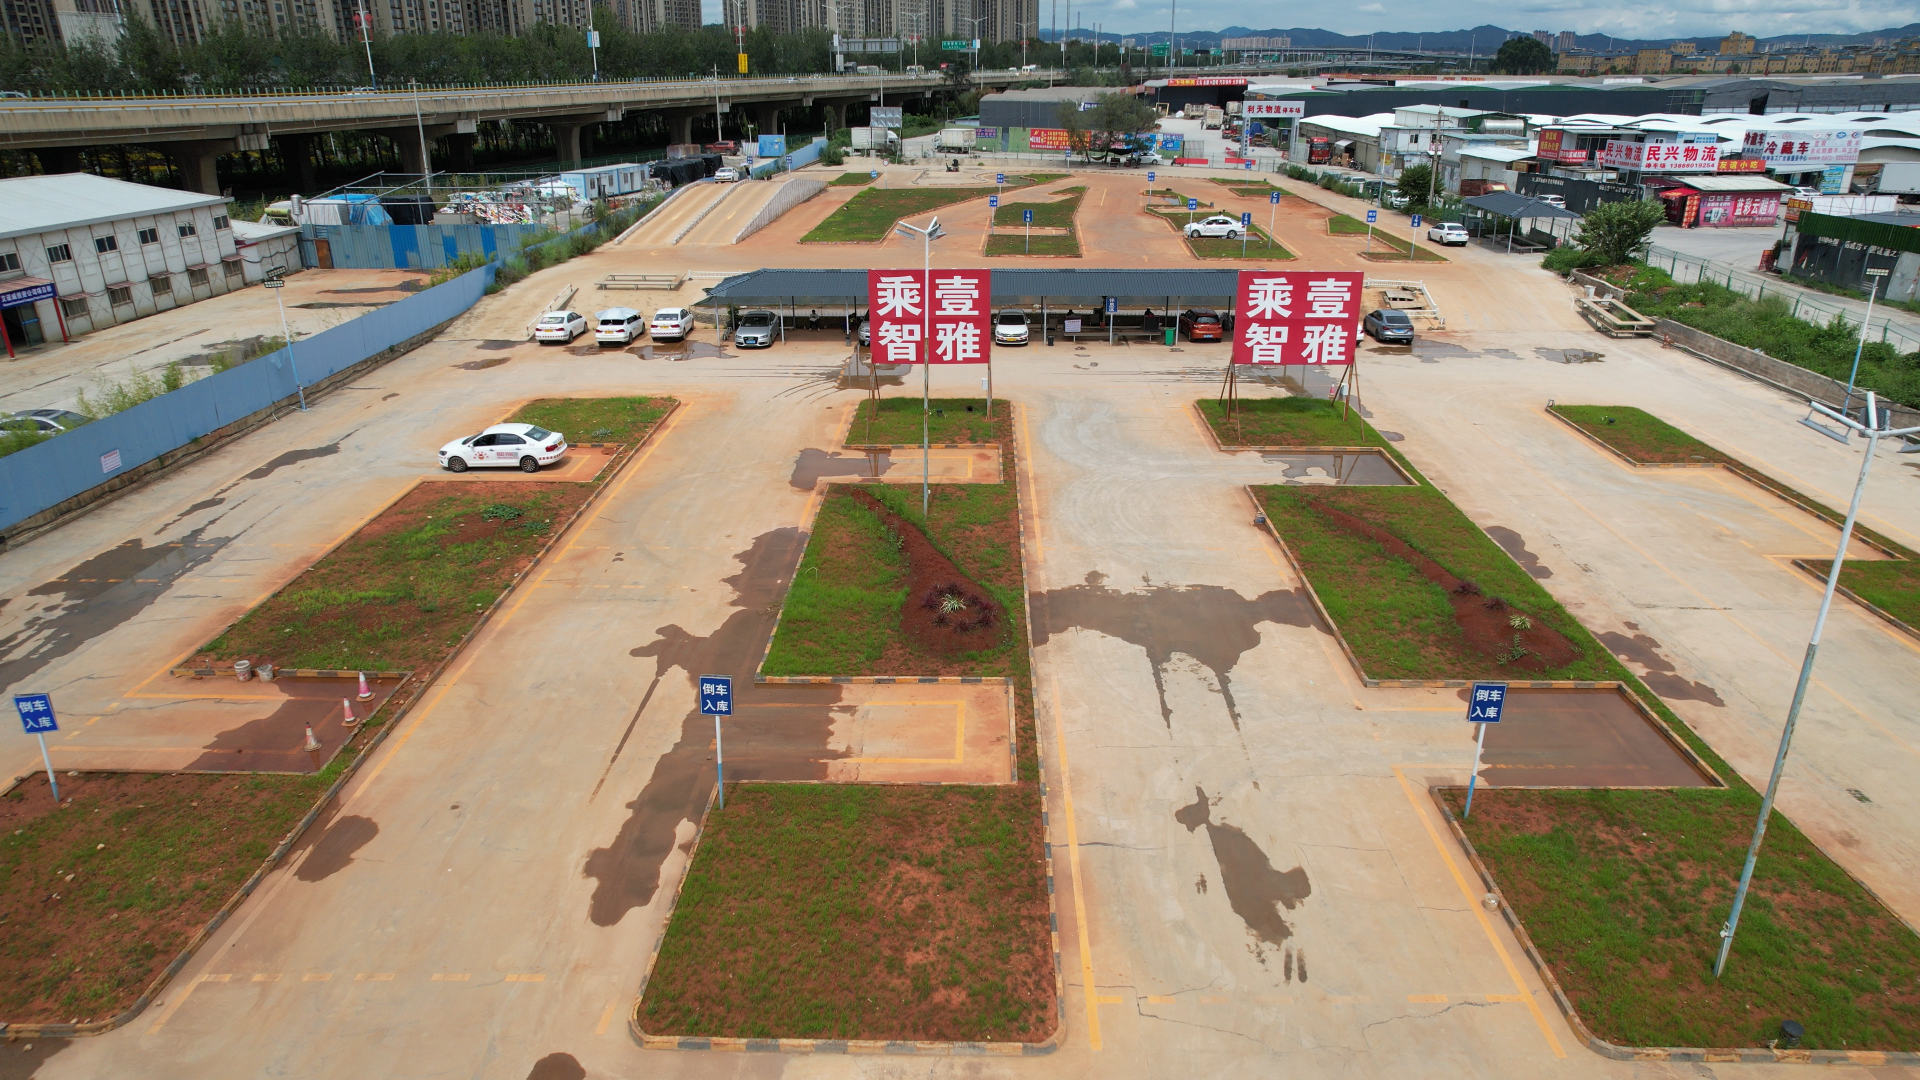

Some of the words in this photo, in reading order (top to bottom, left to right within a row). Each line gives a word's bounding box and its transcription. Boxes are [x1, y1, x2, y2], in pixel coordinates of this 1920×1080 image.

[1605, 142, 1643, 162] 民兴物流
[1646, 145, 1718, 162] 民兴物流
[1764, 141, 1811, 155] 冷藏车
[1719, 160, 1759, 169] 友谊小吃
[703, 683, 728, 696] 倒车
[1475, 689, 1502, 702] 倒车
[18, 700, 48, 713] 倒车
[703, 699, 729, 712] 入库
[1471, 706, 1498, 718] 入库
[26, 716, 53, 729] 入库
